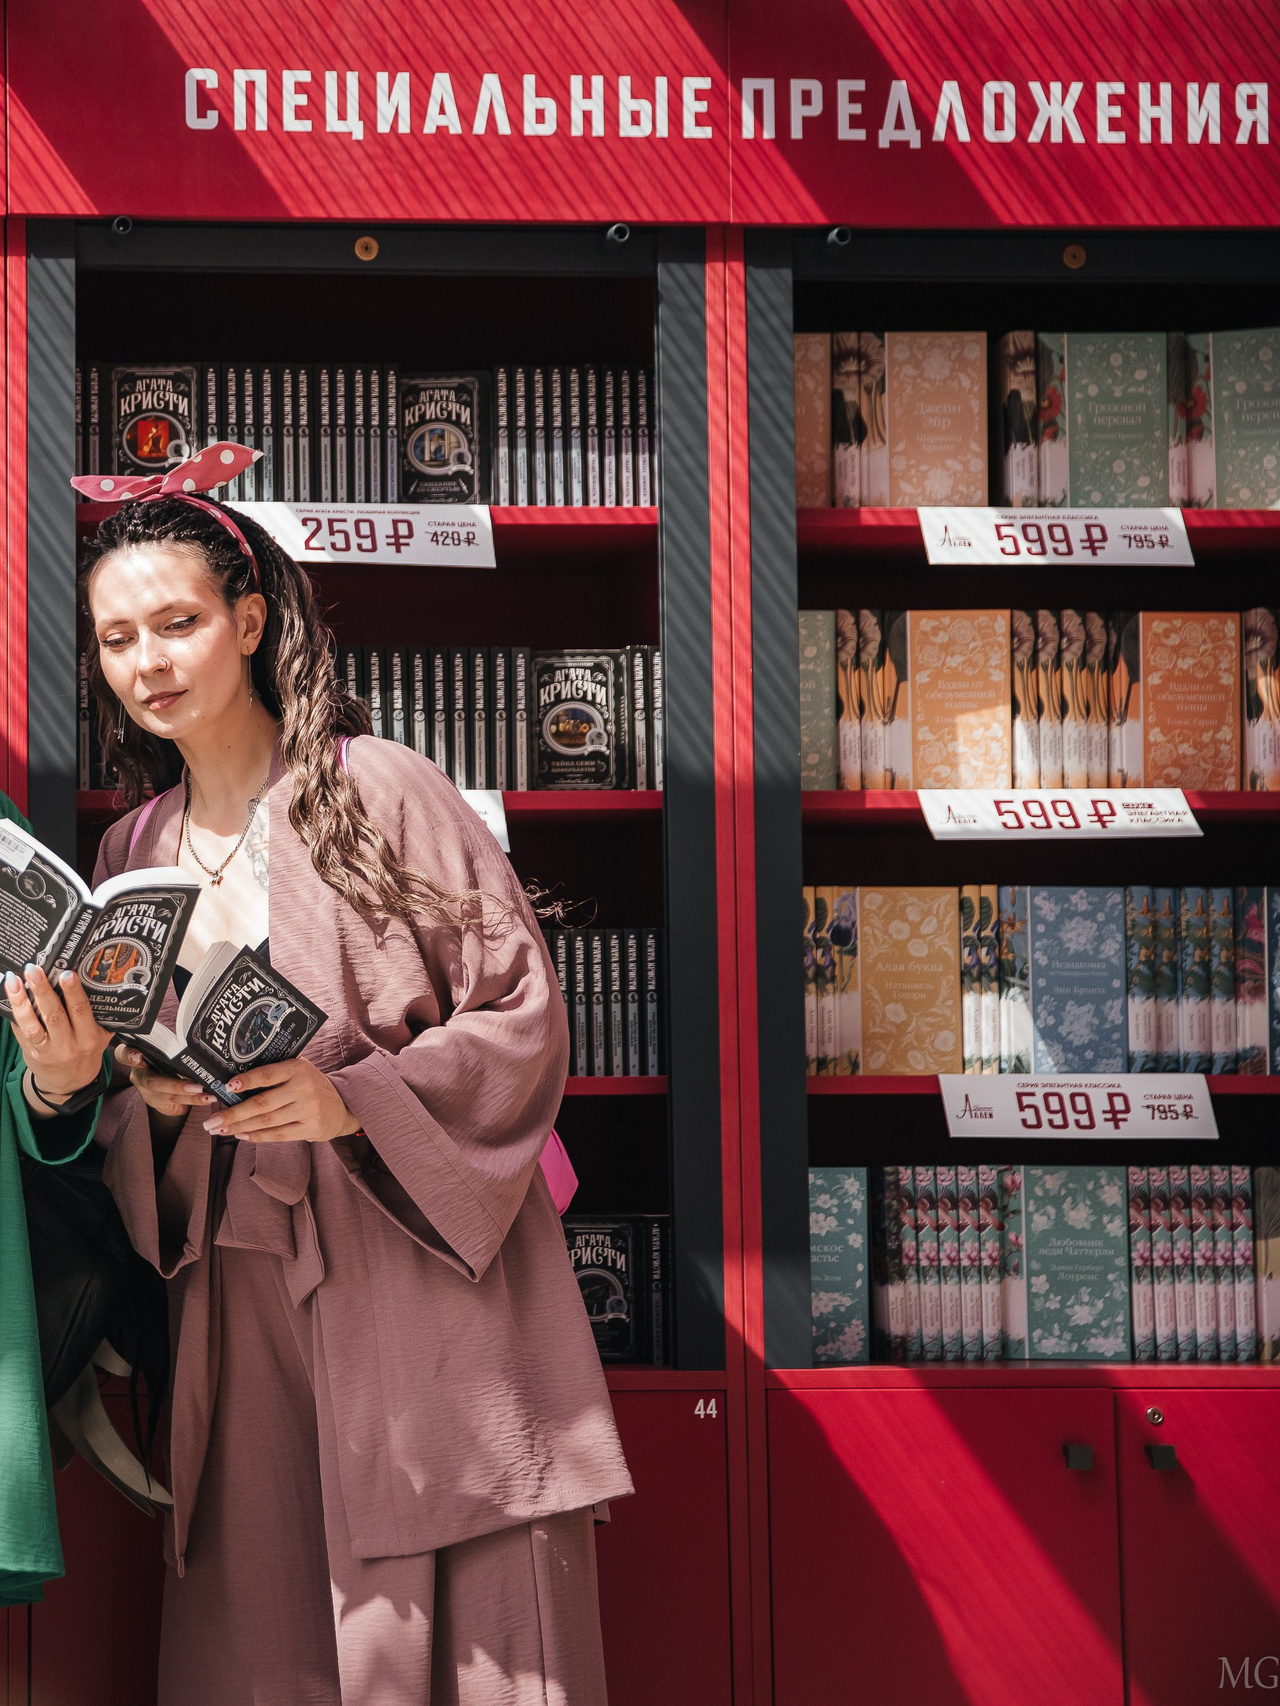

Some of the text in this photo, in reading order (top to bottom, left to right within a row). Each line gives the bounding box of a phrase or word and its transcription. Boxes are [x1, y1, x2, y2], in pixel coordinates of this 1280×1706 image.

[184, 67, 1269, 149] СПЕЦИАЛЬНЫЕ ПРЕДЛОЖЕНИЯ
[136, 379, 173, 392] АГАТА
[420, 389, 456, 402] АГАТА
[120, 391, 188, 416] КРИСТИ
[404, 401, 470, 427] КРИСТИ
[301, 516, 378, 553] 259
[994, 523, 1074, 556] 599
[554, 668, 591, 682] АГАТА
[540, 680, 607, 706] КРИСТИ
[994, 800, 1081, 830] 599
[112, 904, 156, 919] АГАТА
[88, 916, 167, 946] КРИСТИ
[876, 961, 944, 972] Алая буква
[89, 995, 118, 1003] ДЕЛО
[210, 983, 241, 1024] АГАТА
[212, 976, 265, 1051] КРИСТИ
[1016, 1092, 1096, 1130] 599
[576, 1234, 611, 1248] АГАТА
[694, 1398, 717, 1419] 44
